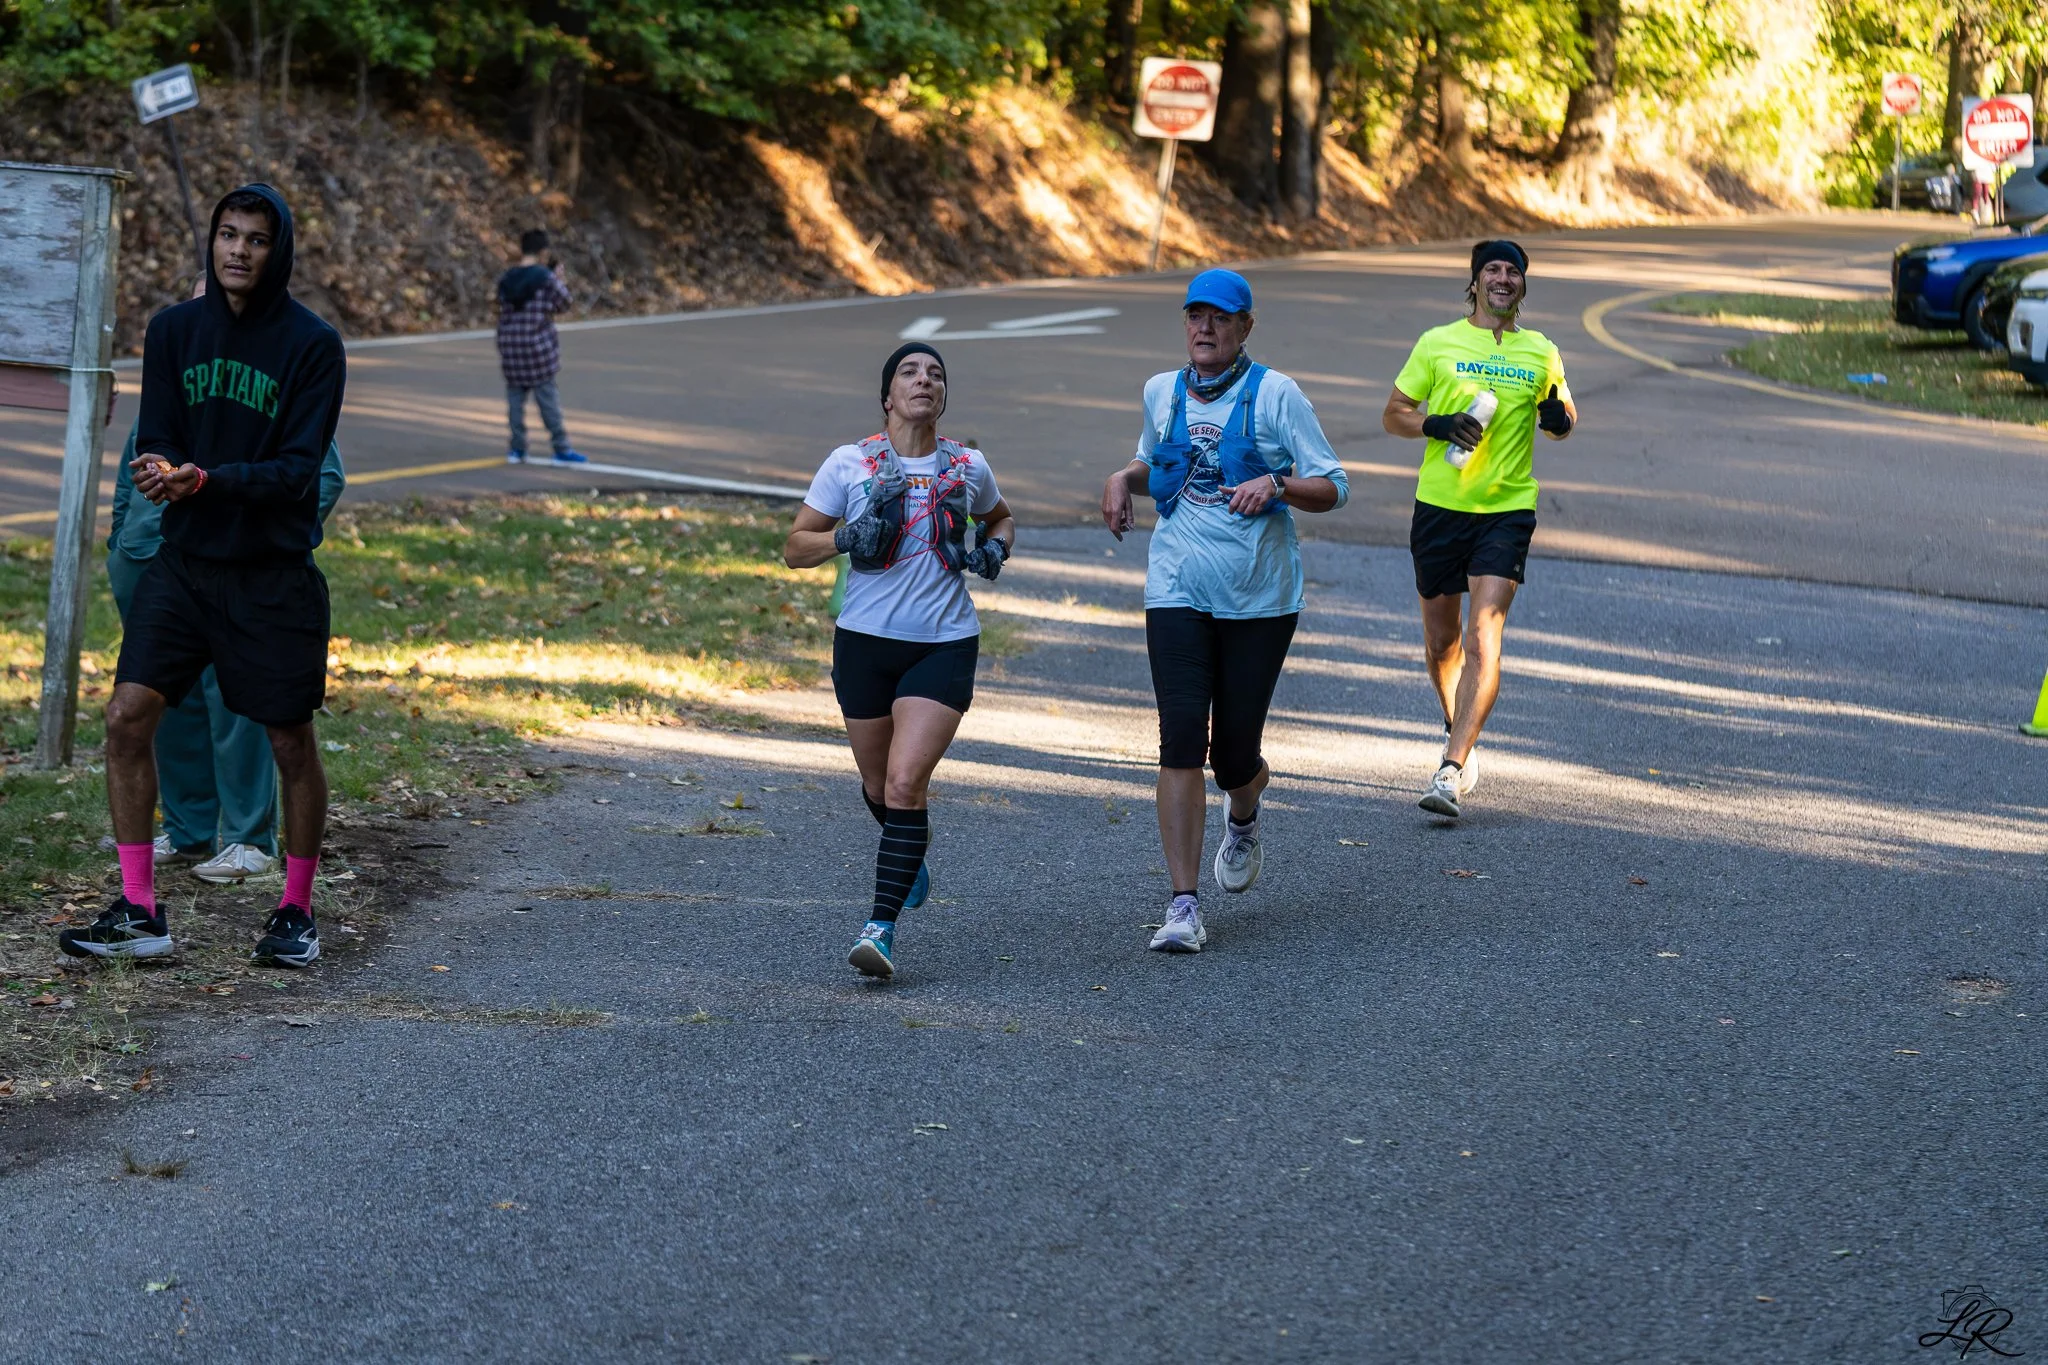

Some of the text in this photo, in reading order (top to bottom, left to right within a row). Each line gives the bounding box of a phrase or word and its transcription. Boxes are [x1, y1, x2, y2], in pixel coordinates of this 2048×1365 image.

[1973, 108, 2021, 124] DO NOT
[1456, 362, 1535, 383] BAYSHORE
[183, 358, 280, 418] SPRTANS
[1201, 427, 1221, 438] SERIE
